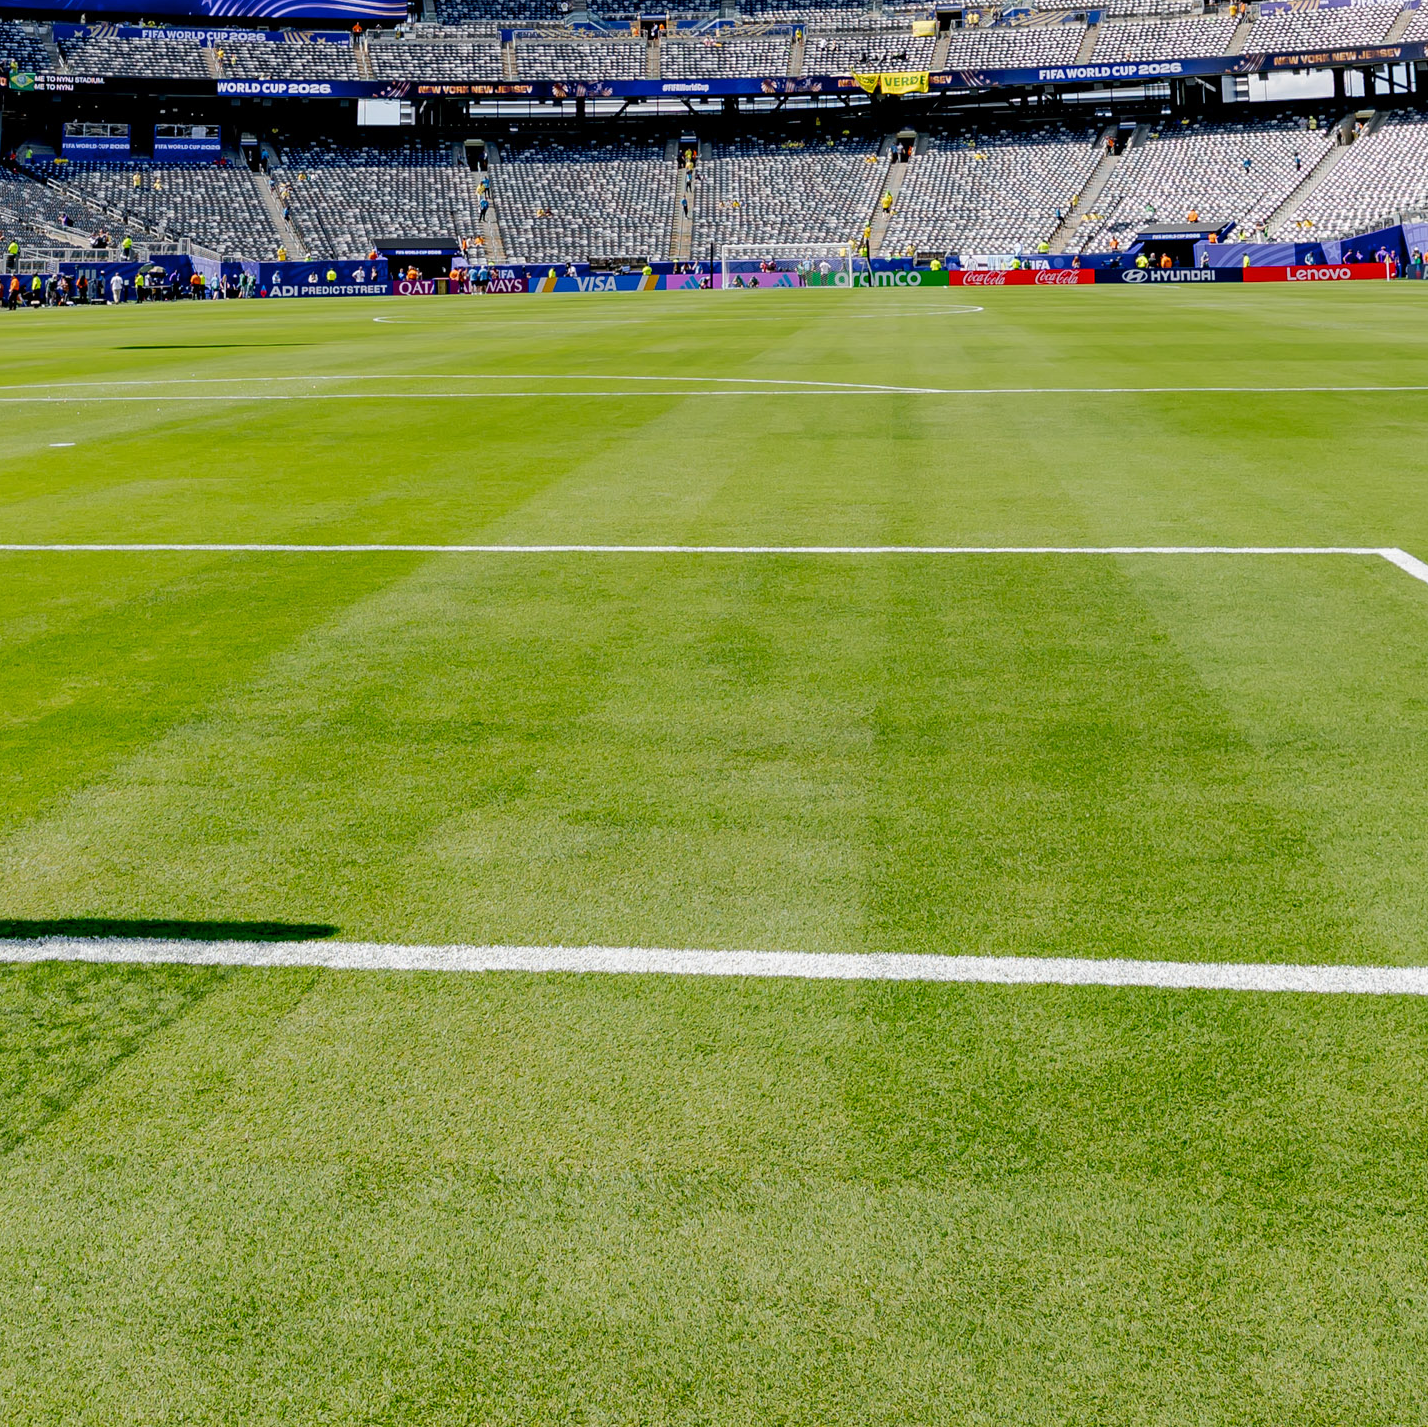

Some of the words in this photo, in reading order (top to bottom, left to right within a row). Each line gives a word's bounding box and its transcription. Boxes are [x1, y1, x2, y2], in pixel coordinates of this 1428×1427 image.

[142, 29, 165, 40] FIFA
[166, 30, 205, 41] WORLD
[206, 31, 228, 41] CUP
[229, 31, 267, 42] 2026
[1274, 56, 1299, 66] NEW
[1300, 54, 1330, 64] YORK
[1332, 51, 1357, 61] NEW
[1358, 47, 1402, 60] JERSEY
[1038, 68, 1066, 80] FIFA
[1066, 66, 1111, 79] WORLD
[1111, 64, 1137, 76] CUP
[1138, 62, 1182, 75] 2026
[217, 82, 261, 94] WORLD
[262, 82, 287, 94] CUP
[288, 83, 332, 94] 2026
[884, 76, 926, 87] VERDE
[418, 85, 441, 94] NEW
[442, 85, 469, 94] YORK
[471, 85, 493, 94] NEW
[834, 271, 921, 287] aramco
[962, 270, 1007, 285] Coca-Cola
[1035, 269, 1080, 285] Coca-Cola
[1150, 270, 1215, 281] HYUNDAI
[1286, 267, 1351, 281] Lenovo
[270, 285, 299, 297] ADI
[301, 284, 388, 296] PREDICTSTREET
[575, 276, 616, 291] VISA
